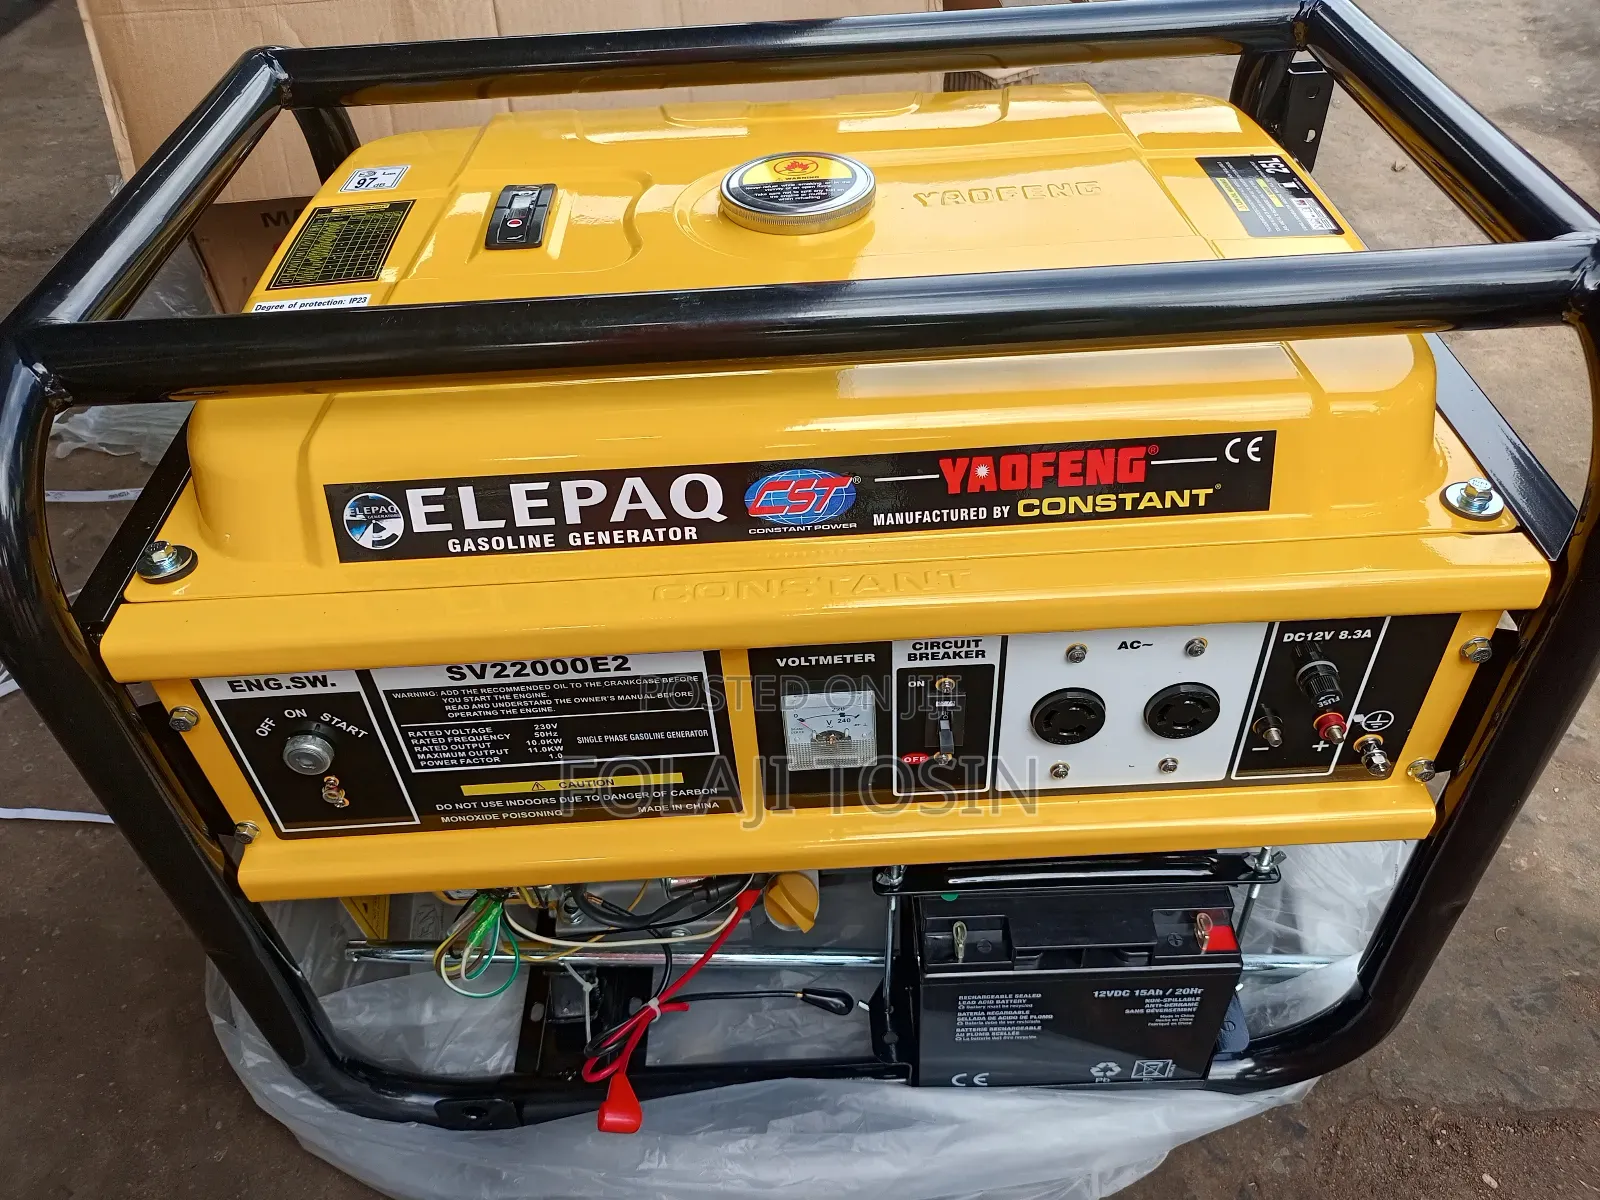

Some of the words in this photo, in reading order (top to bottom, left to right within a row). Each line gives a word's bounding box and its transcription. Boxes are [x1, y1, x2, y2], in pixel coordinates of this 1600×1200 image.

[354, 177, 378, 188] 97
[913, 181, 1101, 207] YAOFENG
[254, 304, 284, 312] Degree
[299, 298, 346, 310] protection:
[349, 296, 368, 304] IP23
[1225, 436, 1264, 463] CE
[938, 447, 1151, 495] YAOFENG
[405, 472, 728, 534] ELEPAQ
[748, 476, 853, 517] CST
[1016, 488, 1214, 518] CONSTANT
[350, 505, 397, 515] ELEPAQ
[873, 507, 988, 527] MANUFACTURED
[992, 506, 1010, 518] BY
[748, 524, 814, 535] CONSTANT
[814, 522, 857, 532] POWER
[448, 532, 556, 554] GASOLINE
[568, 525, 698, 547] GENERATOR
[653, 569, 972, 602] CONSTANT
[1283, 631, 1335, 642] DC12V
[1339, 629, 1372, 640] 8.3A
[912, 639, 982, 651] CIRCUIT
[777, 654, 876, 667] VOLTMETER
[908, 650, 986, 661] BREAKER
[446, 656, 632, 681] SV22000E2
[227, 674, 336, 693] ENG.SW.
[392, 691, 438, 699] WARNING:
[480, 684, 550, 694] RECOMMENDED
[604, 678, 660, 687] CRANKCASE
[492, 699, 551, 708] UNDERSTAND
[574, 695, 616, 704] OWNER'S
[513, 692, 549, 700] ENGINE.
[1317, 695, 1340, 708] FUSE
[284, 708, 307, 719] ON
[448, 710, 498, 718] OPERATING
[256, 717, 276, 737] OFF
[320, 712, 368, 739] START
[408, 730, 442, 738] RATED
[444, 727, 493, 735] VOLTAGE
[448, 734, 511, 743] FREQUENCY
[577, 736, 603, 744] SINGLE
[604, 734, 628, 742] PHASE
[630, 732, 665, 741] GASOLINE
[667, 730, 709, 738] GENERATOR
[450, 742, 492, 750] OUTPUT
[526, 738, 562, 746] 10.0KW
[417, 751, 466, 760] MAXIMUM
[468, 749, 509, 757] OUTPUT
[420, 759, 458, 767] POWER
[559, 779, 615, 789] CAUTION
[455, 802, 478, 810] NOT
[506, 797, 556, 806] INDOORS
[559, 796, 582, 804] DUE
[603, 792, 650, 800] DANGER
[670, 788, 717, 797] CARBON
[638, 805, 669, 813] MADE
[441, 814, 500, 823] MONOXIDE
[502, 810, 563, 819] POISONING
[1093, 990, 1130, 998] 12VDC
[1134, 988, 1163, 996] 15Ah
[952, 1072, 989, 1086] CE
